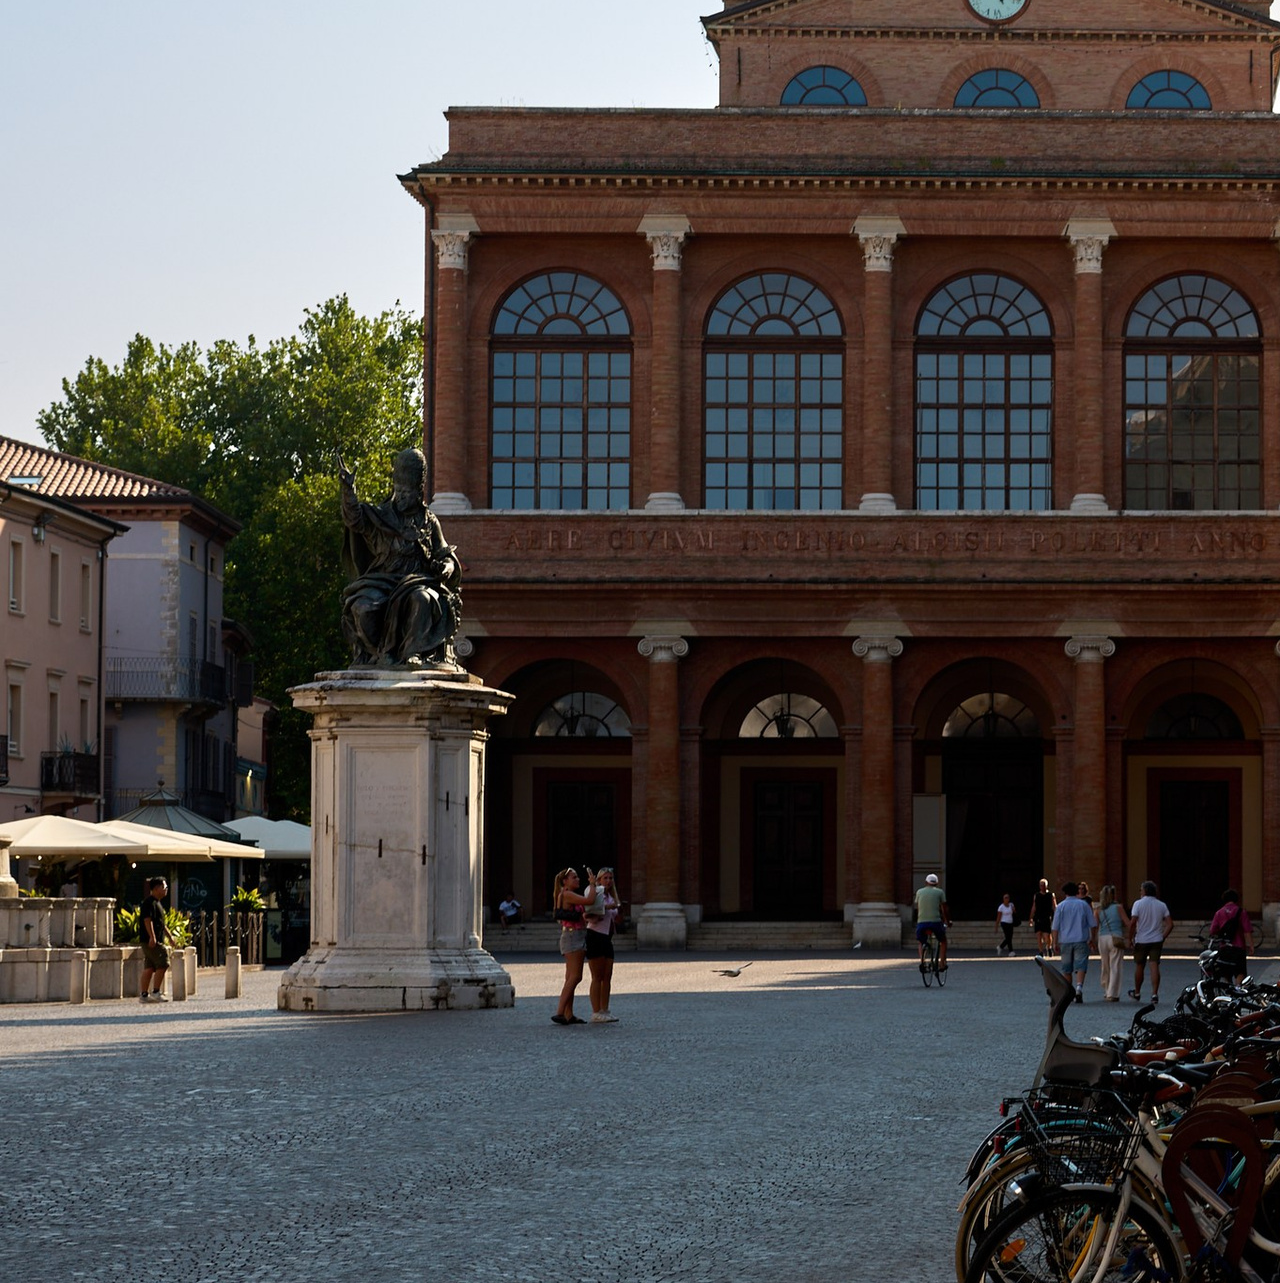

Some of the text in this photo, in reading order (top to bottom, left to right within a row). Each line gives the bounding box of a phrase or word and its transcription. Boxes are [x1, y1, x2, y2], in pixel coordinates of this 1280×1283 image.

[504, 529, 583, 552] AERE
[607, 529, 714, 552] CIVIVM
[740, 530, 865, 552] INGENIO
[890, 530, 1005, 552] ALOISII
[1029, 531, 1163, 552] POLETTI
[1186, 531, 1267, 553] ANNO
